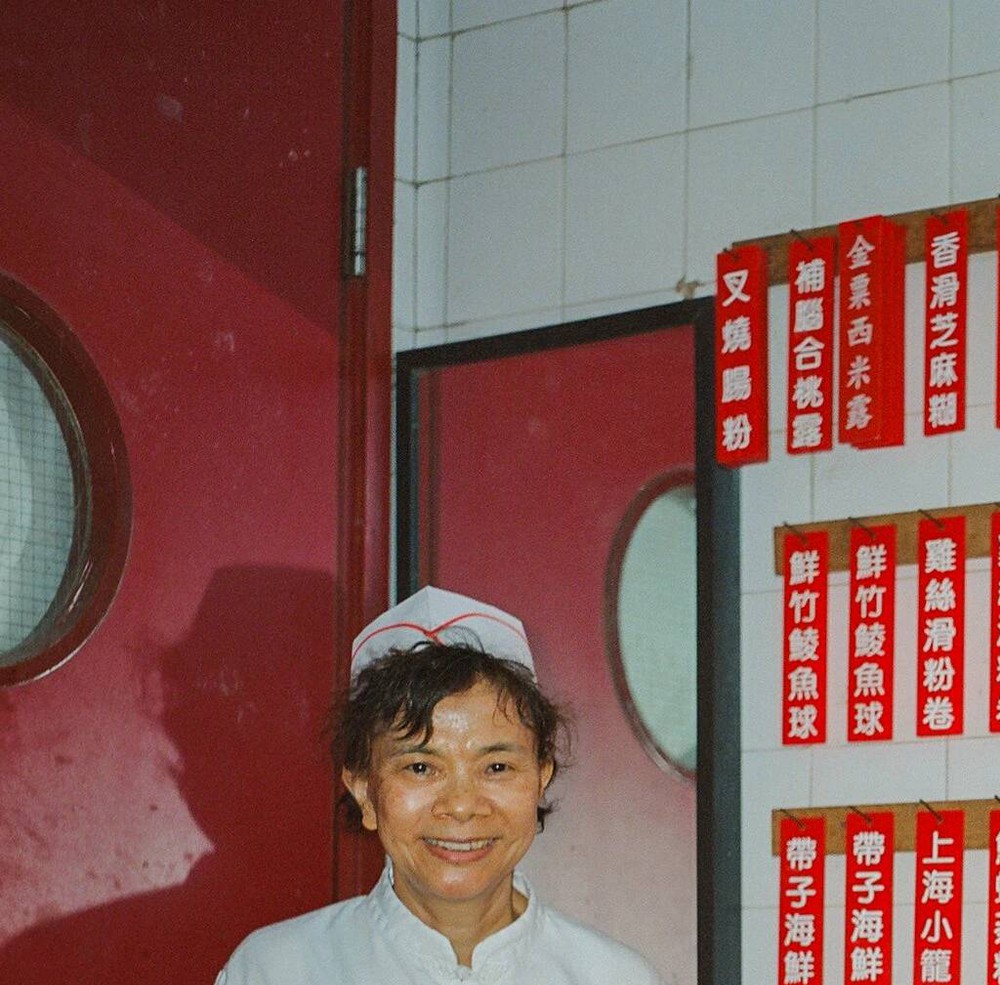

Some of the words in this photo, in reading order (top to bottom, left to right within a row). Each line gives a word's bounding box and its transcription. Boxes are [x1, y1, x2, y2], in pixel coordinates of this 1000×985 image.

[722, 270, 751, 451] 叉燒腸粉
[928, 232, 960, 427] 香滑芝麻糊
[789, 551, 819, 739] 鮮竹鯪魚球
[854, 545, 886, 735] 鮮竹鯪魚球
[923, 538, 956, 730] 雞絲滑粉卷
